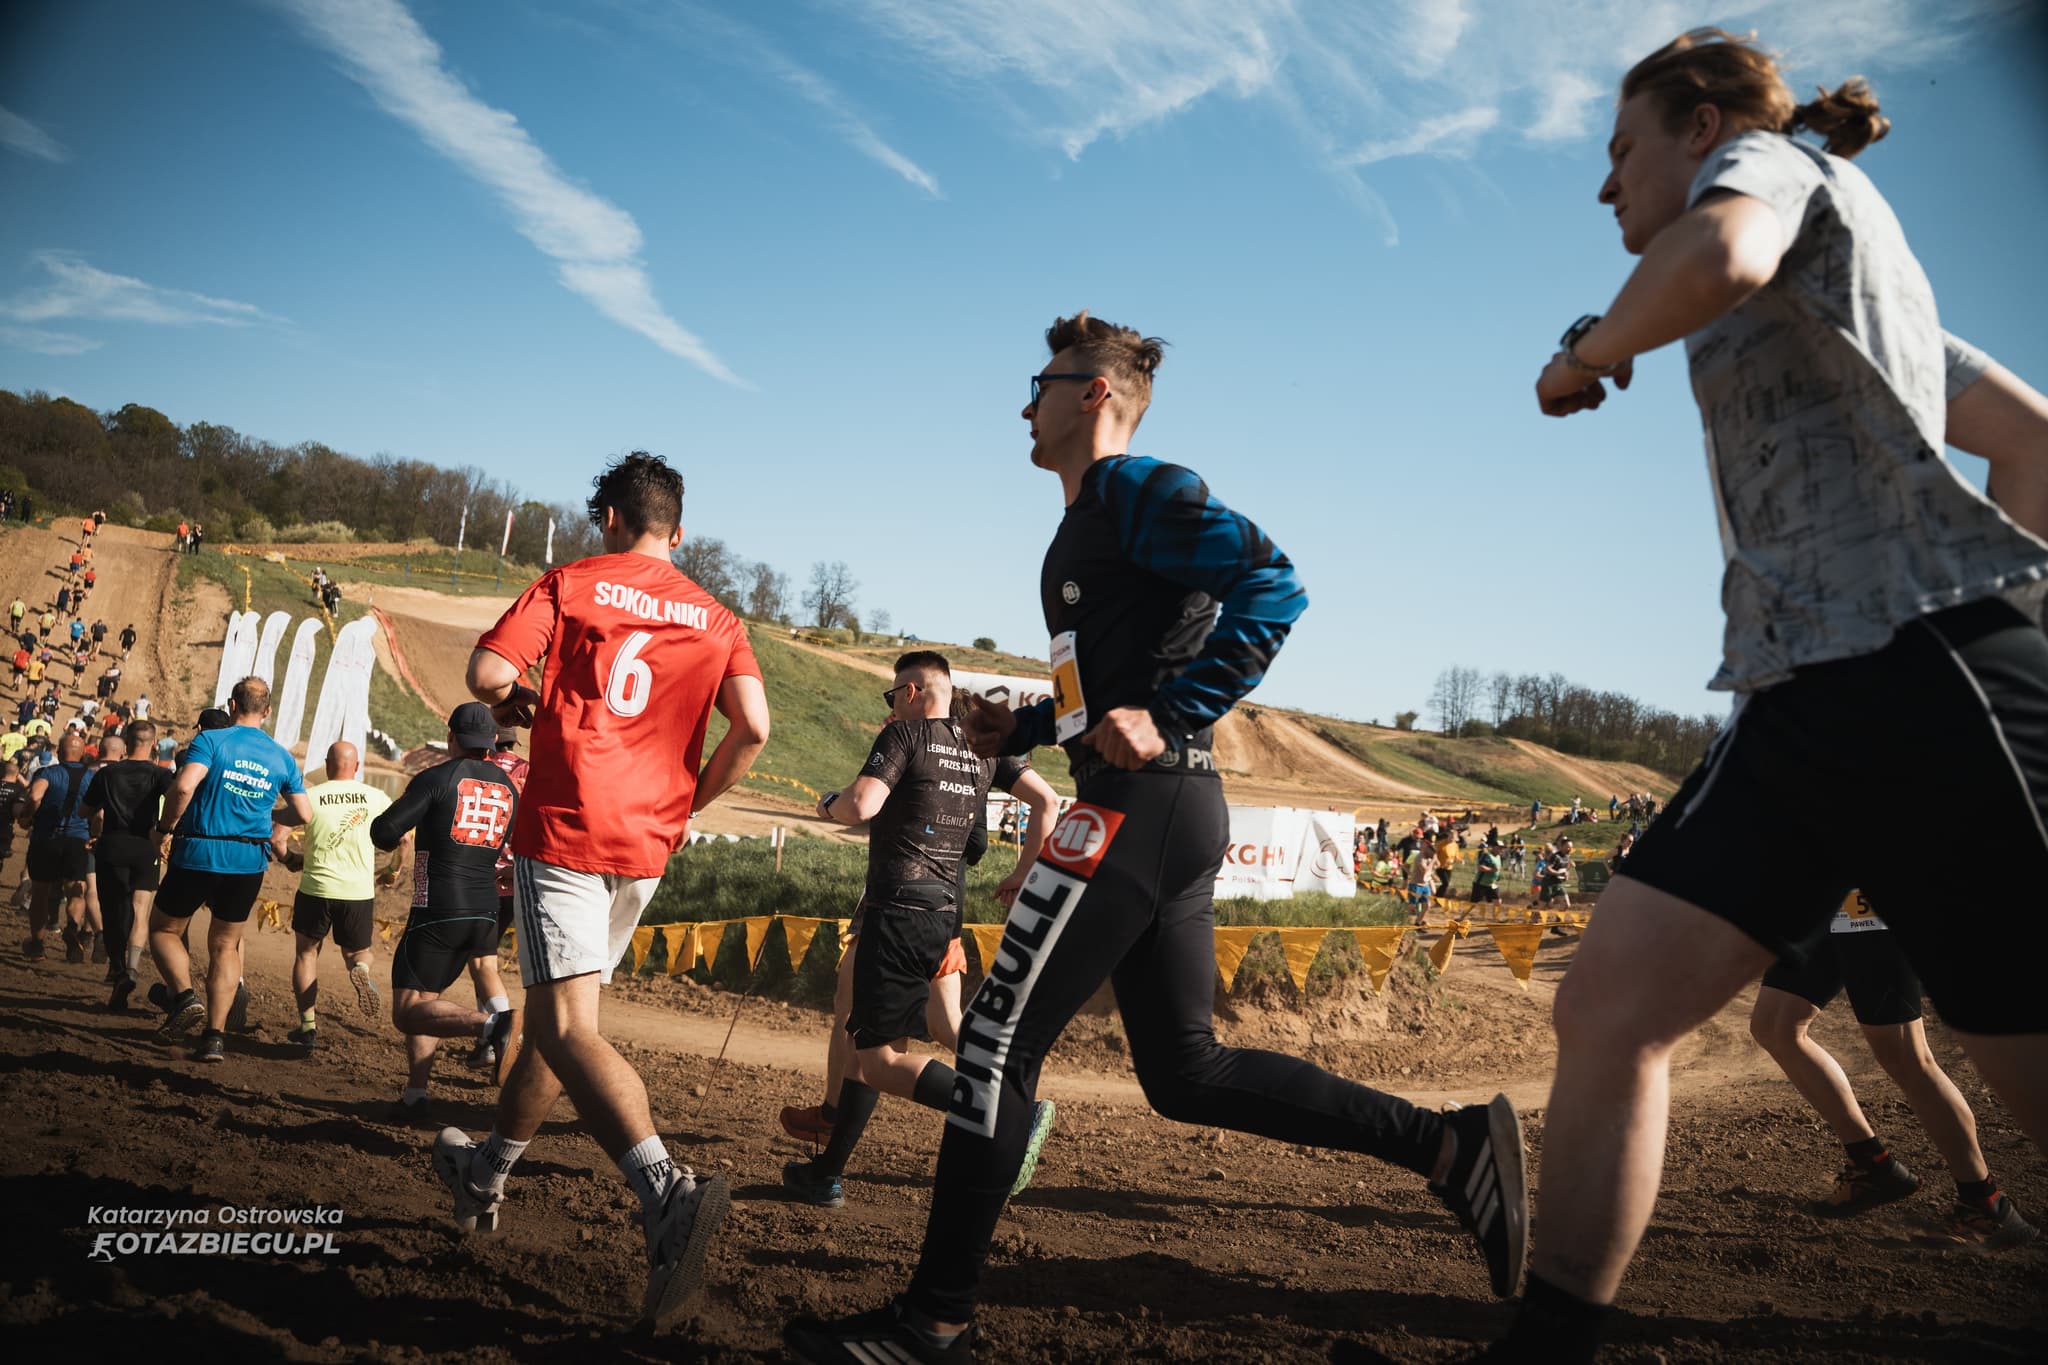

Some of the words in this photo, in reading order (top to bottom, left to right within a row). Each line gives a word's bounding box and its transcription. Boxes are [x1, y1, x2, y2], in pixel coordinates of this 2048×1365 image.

[594, 581, 708, 631] SOKOLNIKI
[605, 631, 653, 718] 6
[927, 743, 958, 757] LEGNICA
[234, 759, 270, 776] GRUPA
[222, 769, 273, 793] NEOFITÓW
[939, 780, 976, 796] RADEK
[223, 781, 265, 799] SZCZECIN
[319, 793, 368, 806] KRZYSIEK
[935, 813, 968, 828] LEGNICA
[952, 884, 1073, 1127] PITBULL
